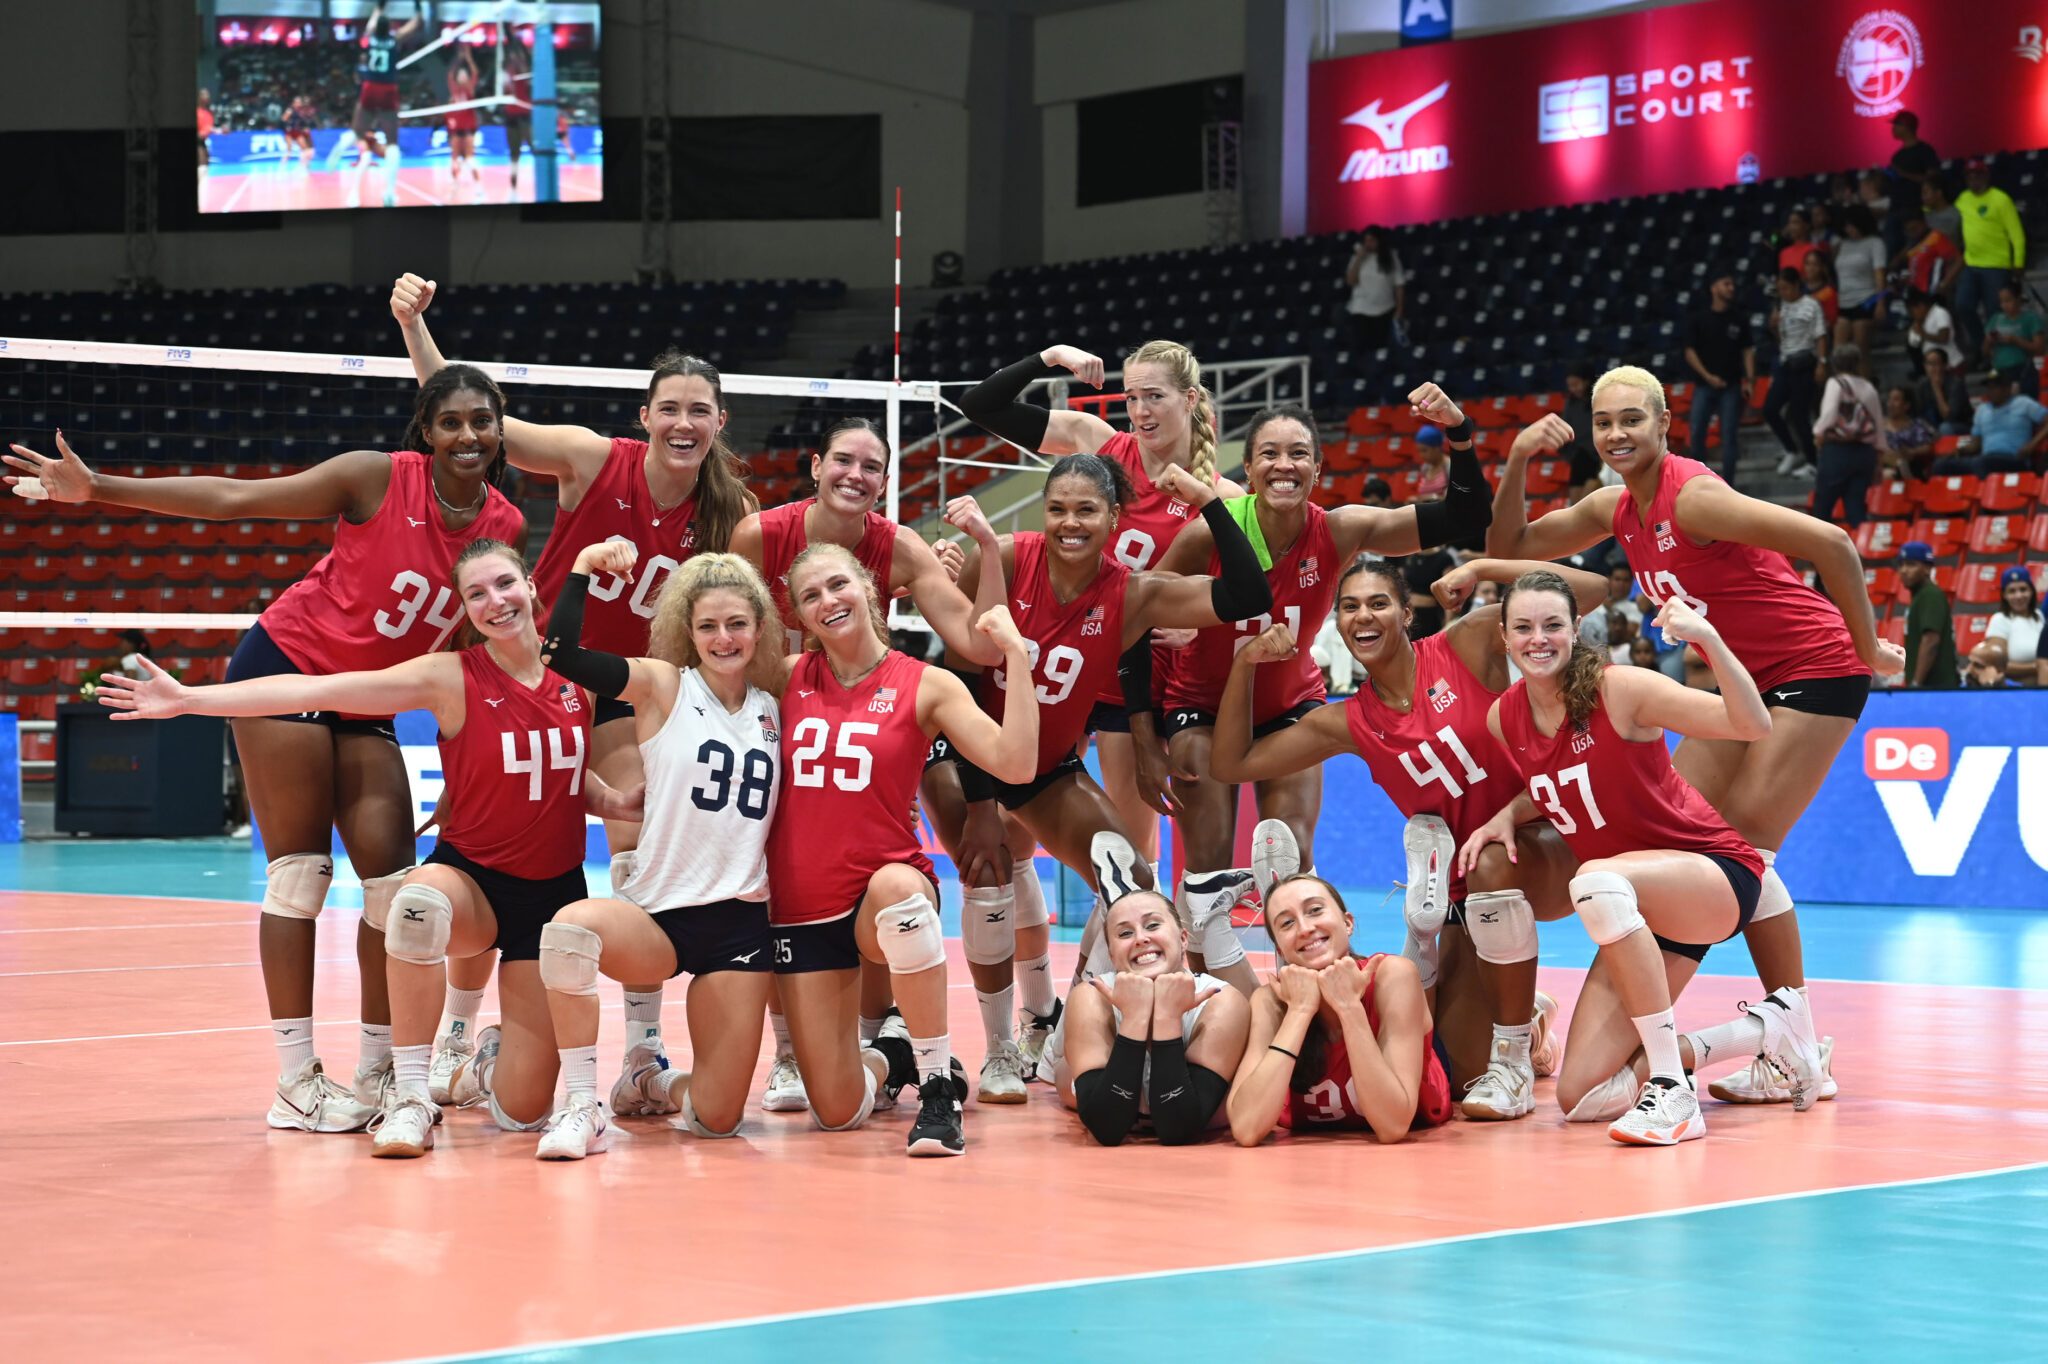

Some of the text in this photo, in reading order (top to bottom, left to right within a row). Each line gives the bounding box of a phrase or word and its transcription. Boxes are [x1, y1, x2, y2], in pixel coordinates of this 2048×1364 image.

[1615, 57, 1753, 96] SPORT
[1615, 88, 1753, 126] COURT
[341, 358, 365, 368] FIVB
[1167, 503, 1188, 520] USA
[1657, 536, 1677, 552] USA
[1299, 571, 1321, 588] USA
[373, 569, 467, 653] 34
[1081, 622, 1102, 636] USA
[868, 701, 894, 714] USA
[1433, 691, 1458, 714] USA
[762, 728, 779, 743] USA
[1571, 734, 1595, 754] USA
[501, 726, 585, 801] 44
[792, 717, 879, 792] 25
[1398, 724, 1488, 800] 41
[1875, 737, 1937, 771] De
[691, 738, 774, 821] 38
[1529, 761, 1606, 835] 37
[1873, 746, 2048, 877] V
[773, 938, 793, 963] 25
